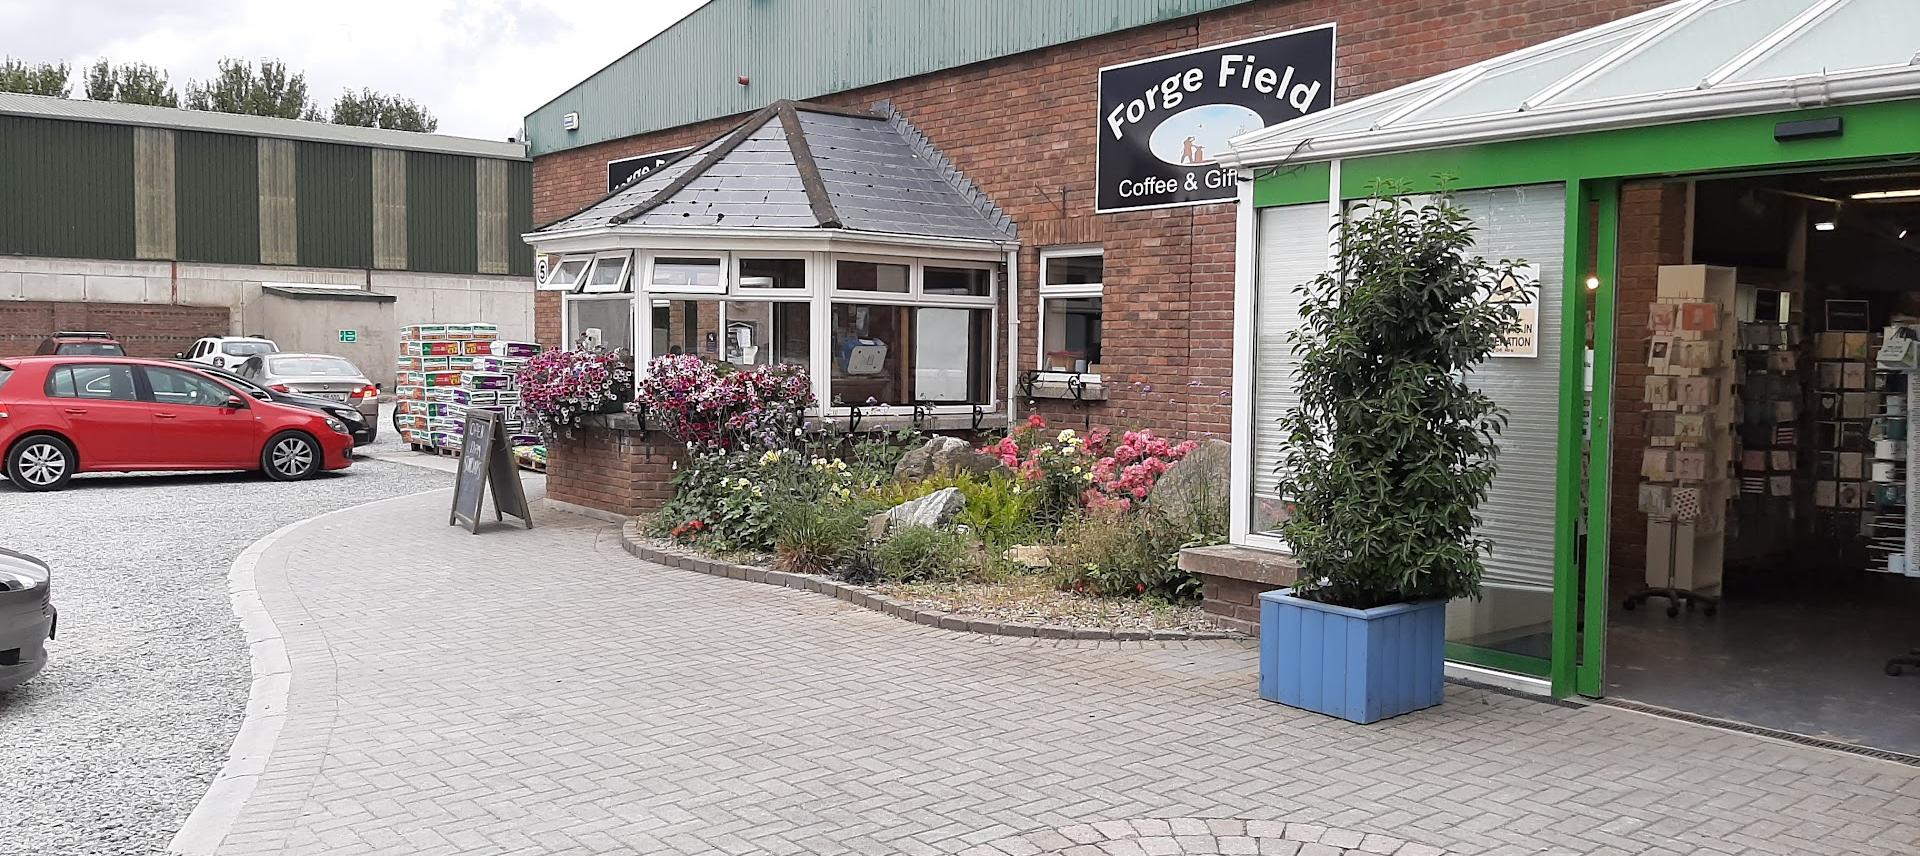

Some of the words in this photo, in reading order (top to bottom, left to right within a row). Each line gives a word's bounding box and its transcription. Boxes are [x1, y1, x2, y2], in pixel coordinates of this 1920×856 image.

[1106, 66, 1204, 140] Forge
[1218, 54, 1322, 114] Field
[1118, 175, 1178, 198] Coffee
[1183, 171, 1198, 191] &
